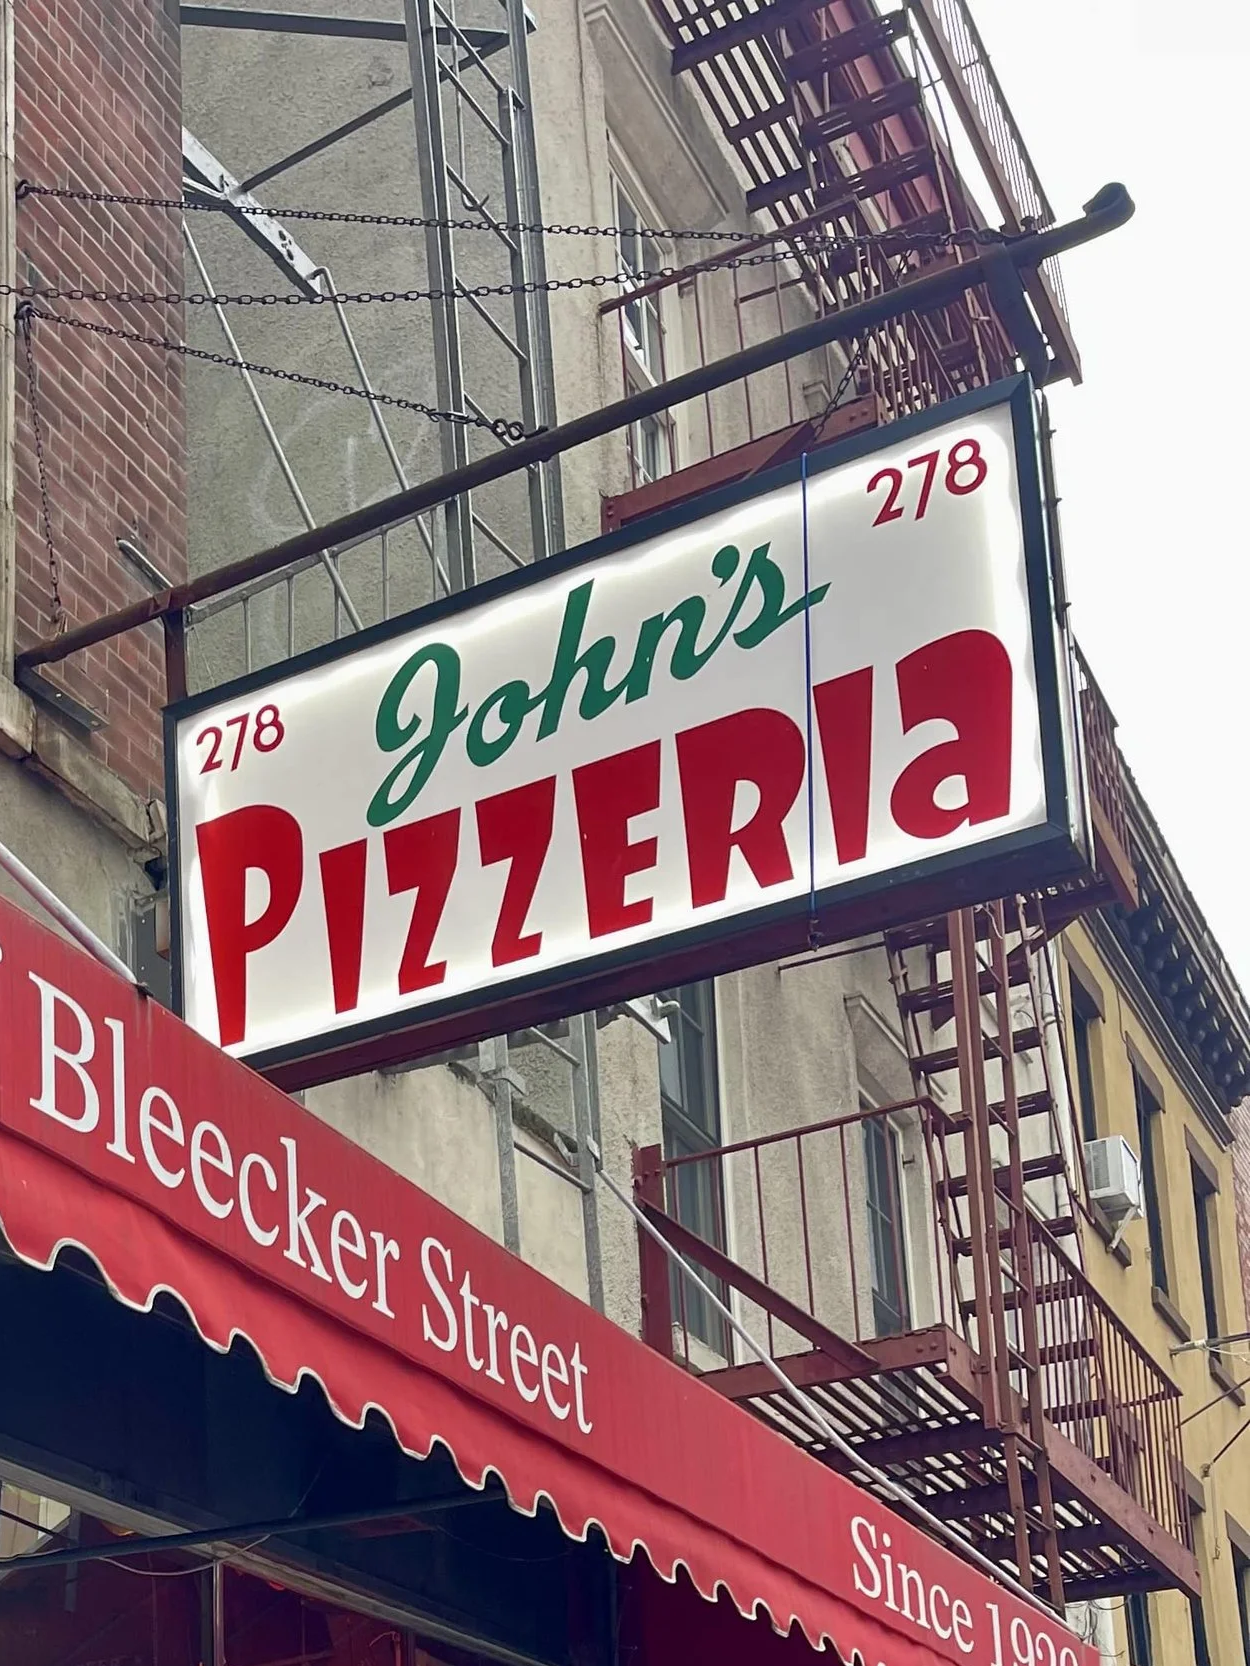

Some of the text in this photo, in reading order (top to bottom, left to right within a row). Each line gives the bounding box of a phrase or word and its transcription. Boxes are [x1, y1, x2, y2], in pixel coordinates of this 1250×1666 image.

[865, 438, 988, 527] 278
[195, 703, 285, 774] 278
[366, 540, 831, 827] John's
[28, 971, 400, 1319] Bleecker
[420, 1236, 593, 1435] Street
[850, 1516, 975, 1653] Since
